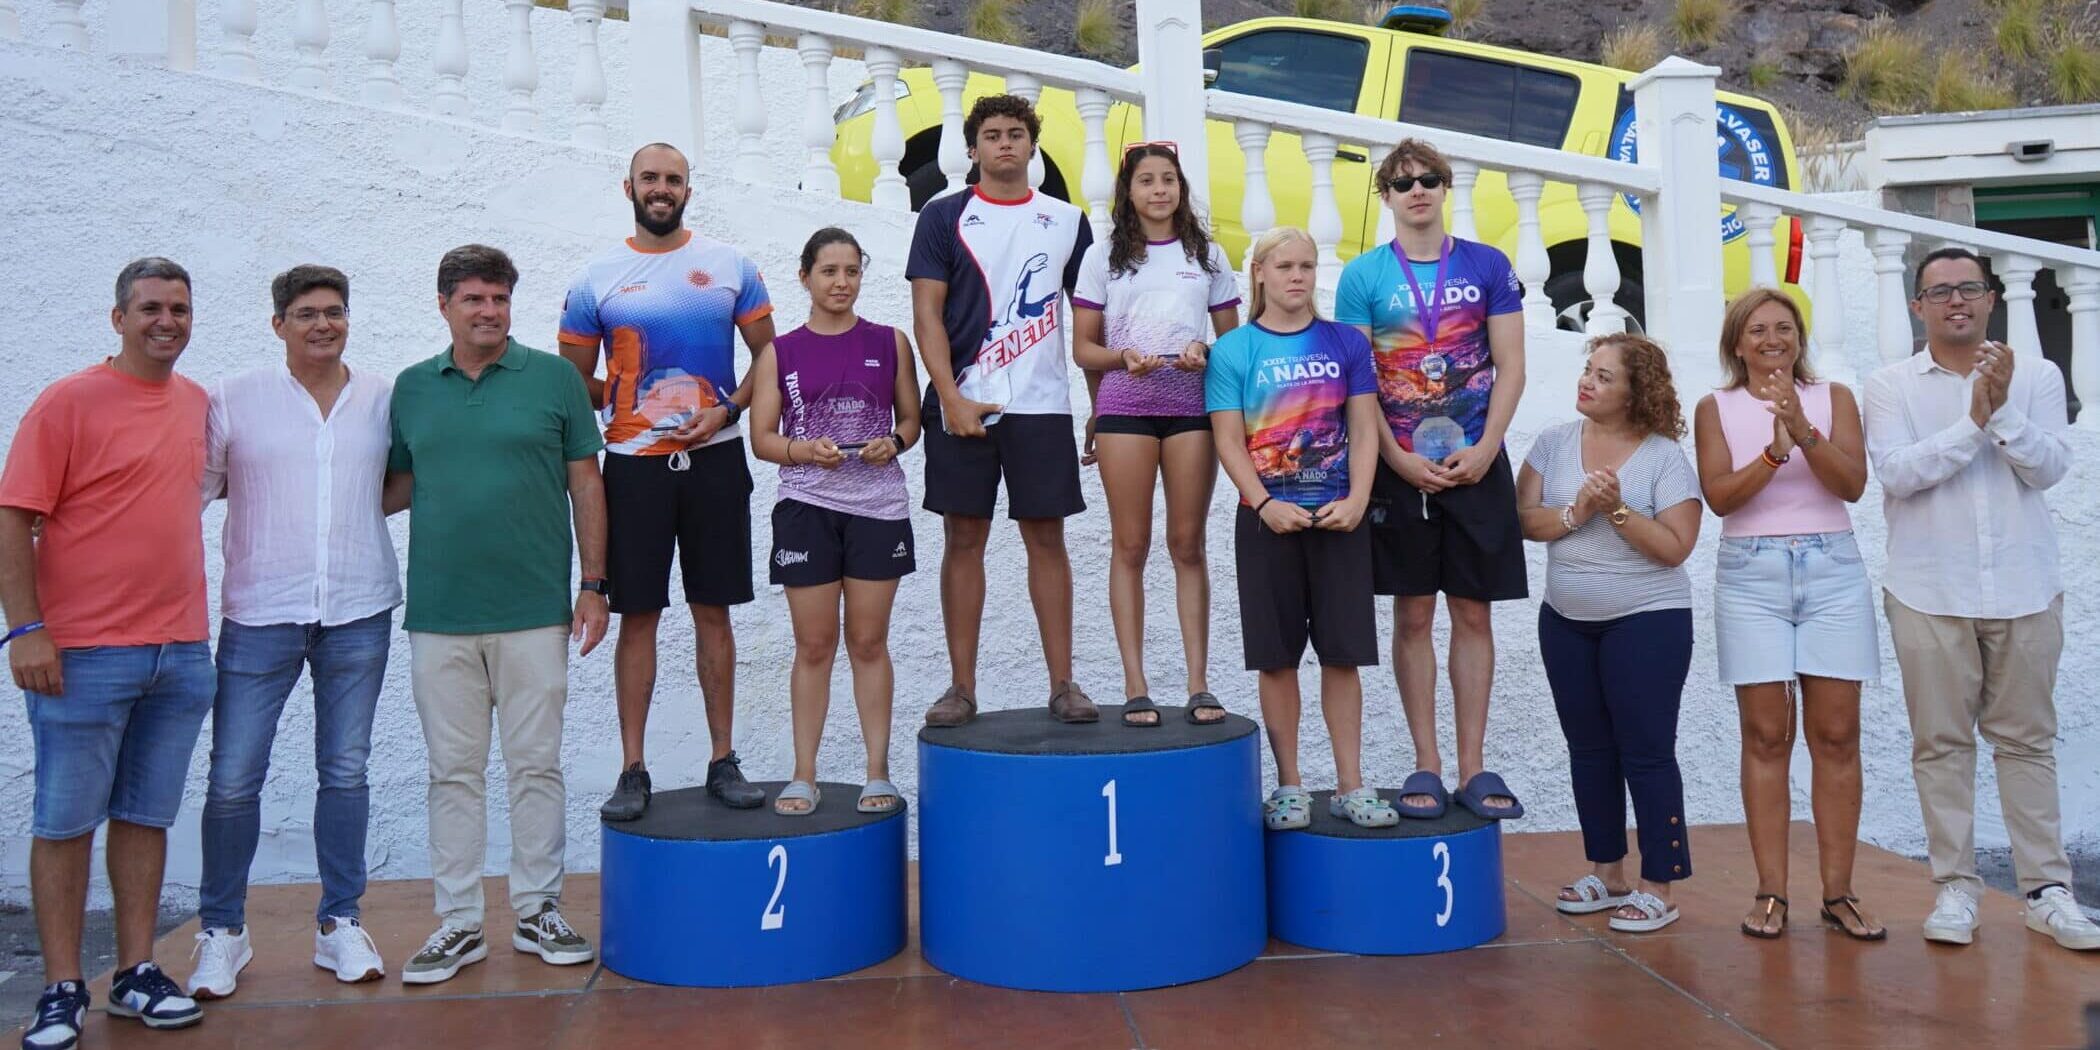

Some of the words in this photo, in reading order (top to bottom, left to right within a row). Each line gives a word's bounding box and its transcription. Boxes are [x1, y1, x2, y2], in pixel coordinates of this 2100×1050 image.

[1389, 293, 1403, 311] A
[1288, 352, 1330, 362] TRAVESÍA
[1256, 370, 1269, 388] A
[1273, 361, 1340, 383] NADO
[837, 399, 865, 412] NADO
[1302, 470, 1328, 480] NADO
[1102, 779, 1122, 866] 1
[761, 845, 787, 930] 2
[1433, 842, 1453, 927] 3
